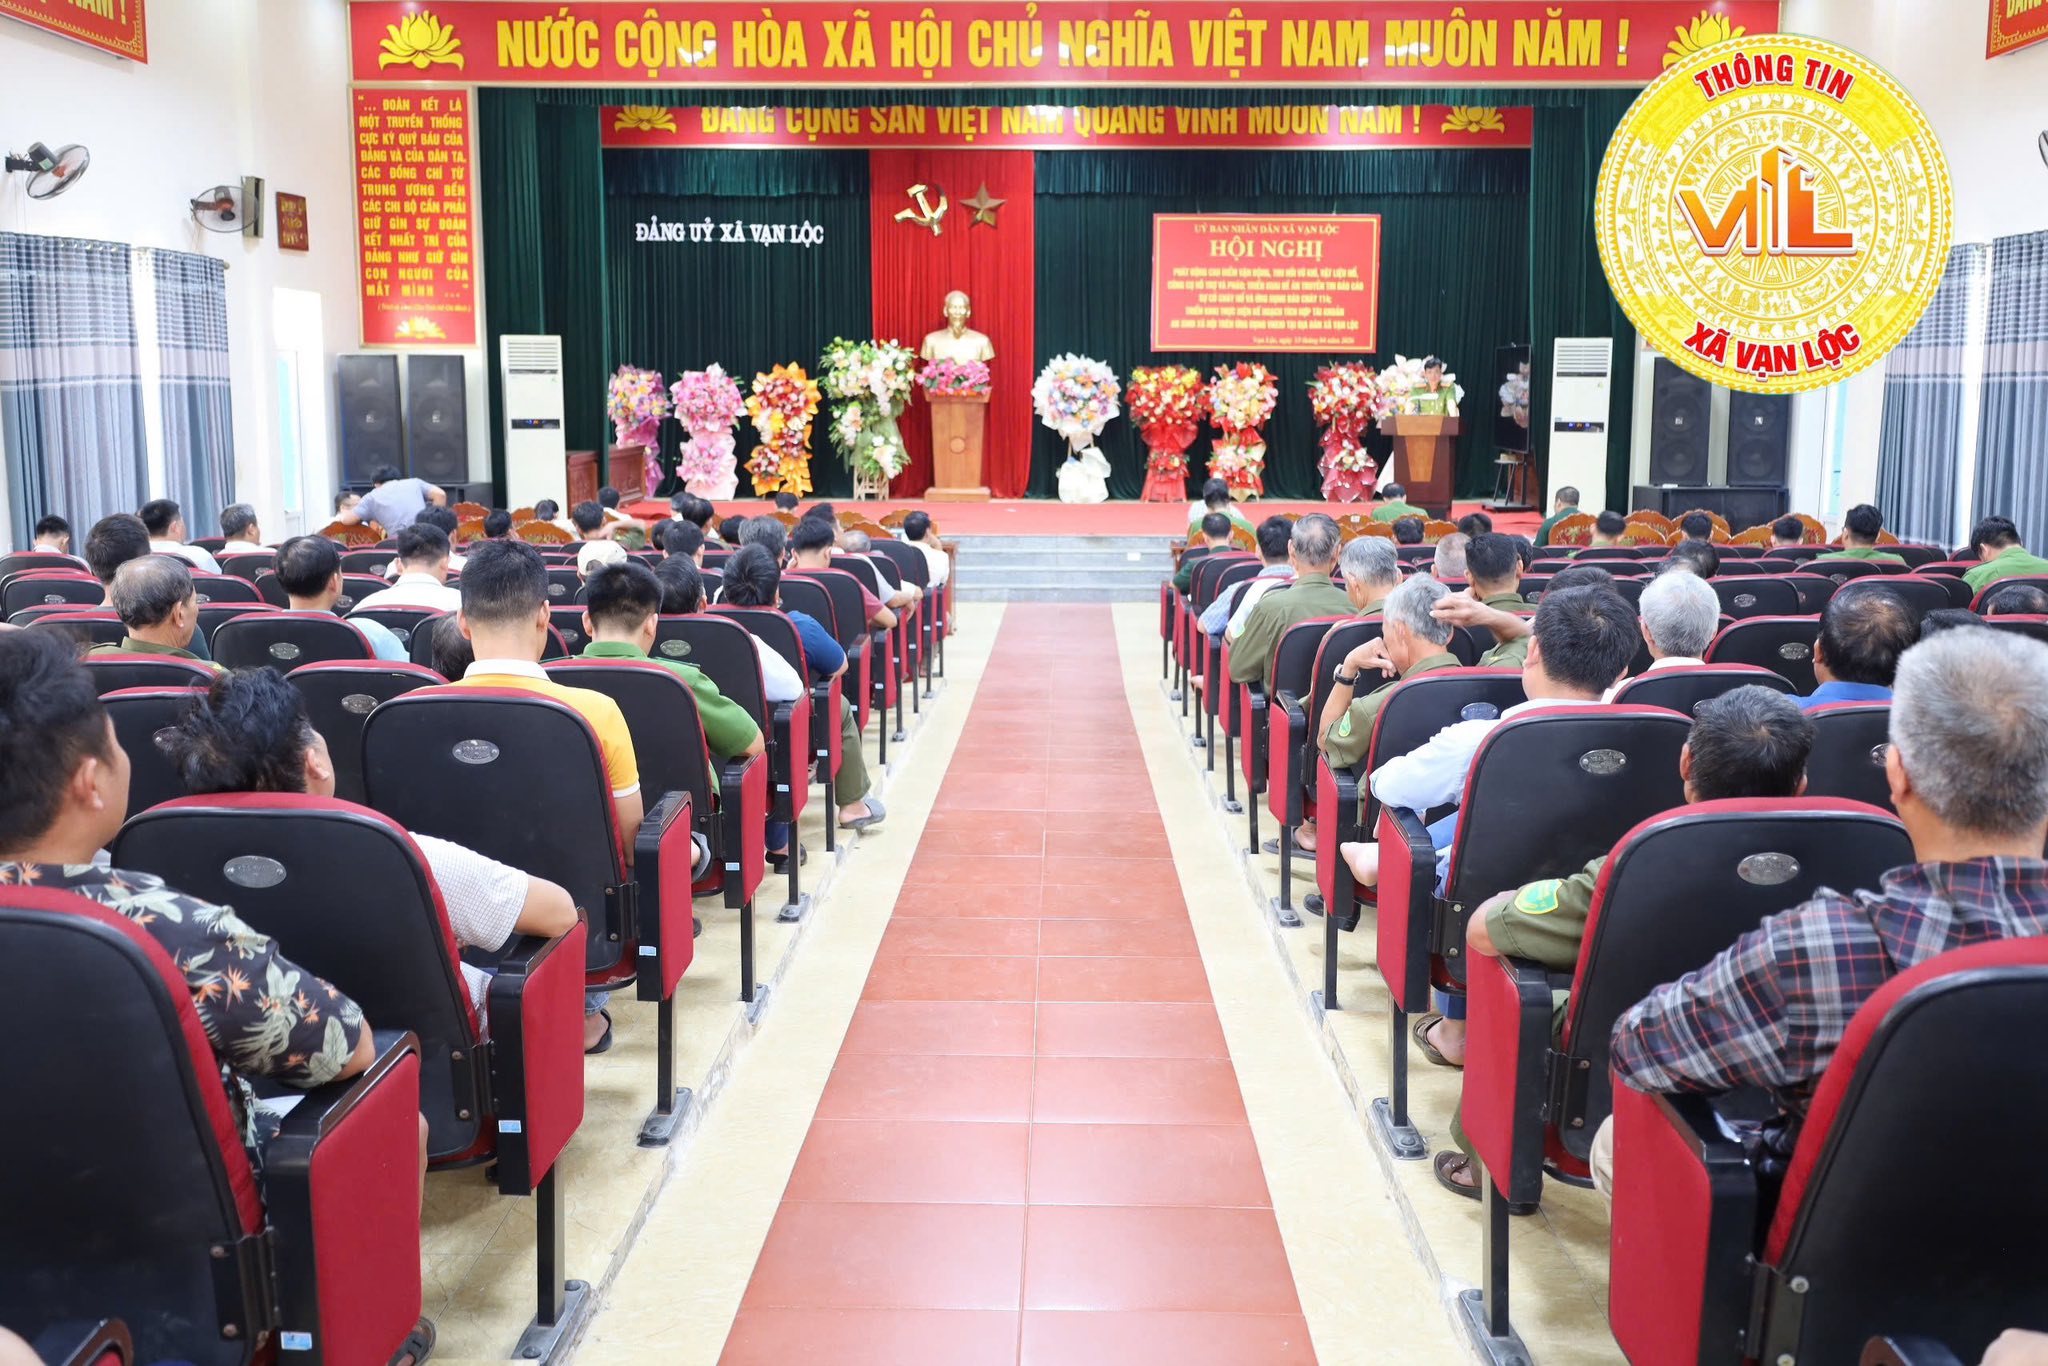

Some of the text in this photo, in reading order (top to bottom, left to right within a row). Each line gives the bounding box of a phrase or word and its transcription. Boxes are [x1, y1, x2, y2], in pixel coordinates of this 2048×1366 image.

[498, 1, 1630, 79] NƯỚC CỘNG HÒA XÃ HỘI CHỦ NGHĨA VIỆT NAM MUÔN NĂM !
[1001, 105, 1064, 135] NAM
[1072, 105, 1165, 135] QUANG
[1175, 105, 1237, 135] VINH
[635, 215, 686, 242] ĐẢNG
[719, 220, 746, 243] XÃ
[749, 224, 786, 247] VẠN
[789, 220, 824, 248] LỘC
[1210, 235, 1323, 262] HỘI NGHỊ
